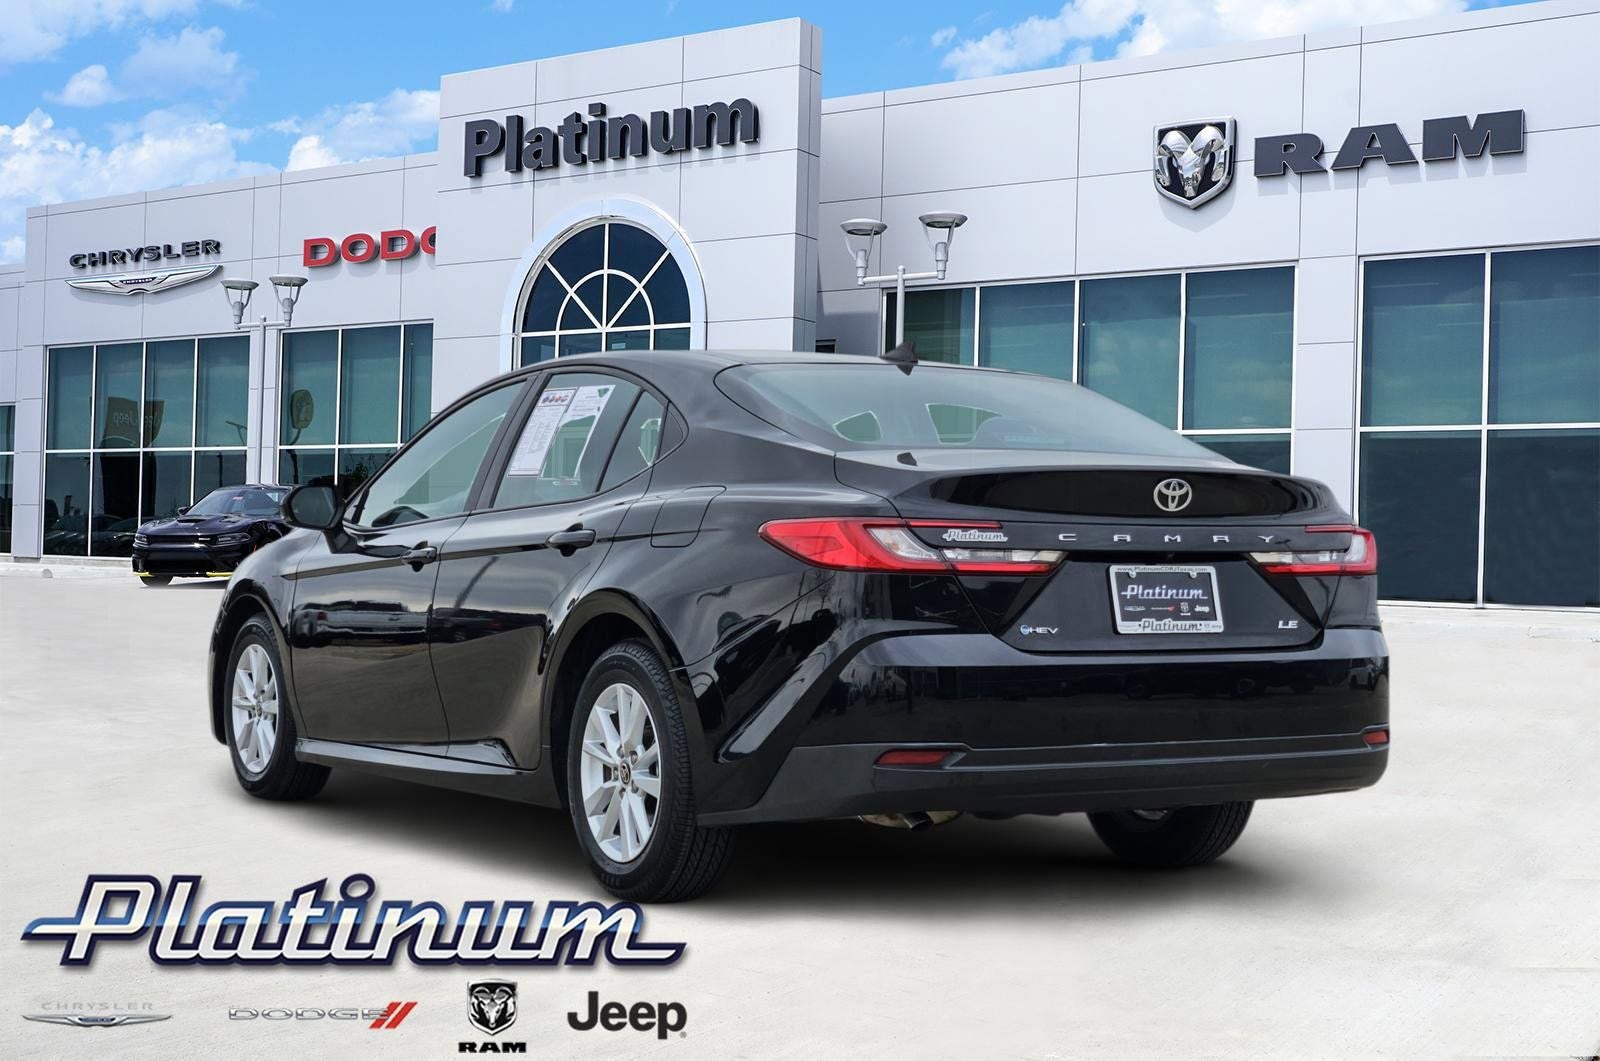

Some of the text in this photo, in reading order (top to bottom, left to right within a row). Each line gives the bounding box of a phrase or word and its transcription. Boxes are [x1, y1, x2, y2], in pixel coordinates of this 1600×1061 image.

[463, 97, 760, 178] Platinum
[1254, 109, 1525, 178] RAM
[69, 239, 221, 269] CHRYSLER
[942, 529, 1008, 542] Platinum
[1058, 533, 1275, 543] CAMRY
[1121, 585, 1208, 599] Platinum
[1029, 626, 1058, 634] HEV
[1141, 619, 1201, 631] Platinum
[1277, 620, 1298, 629] LE
